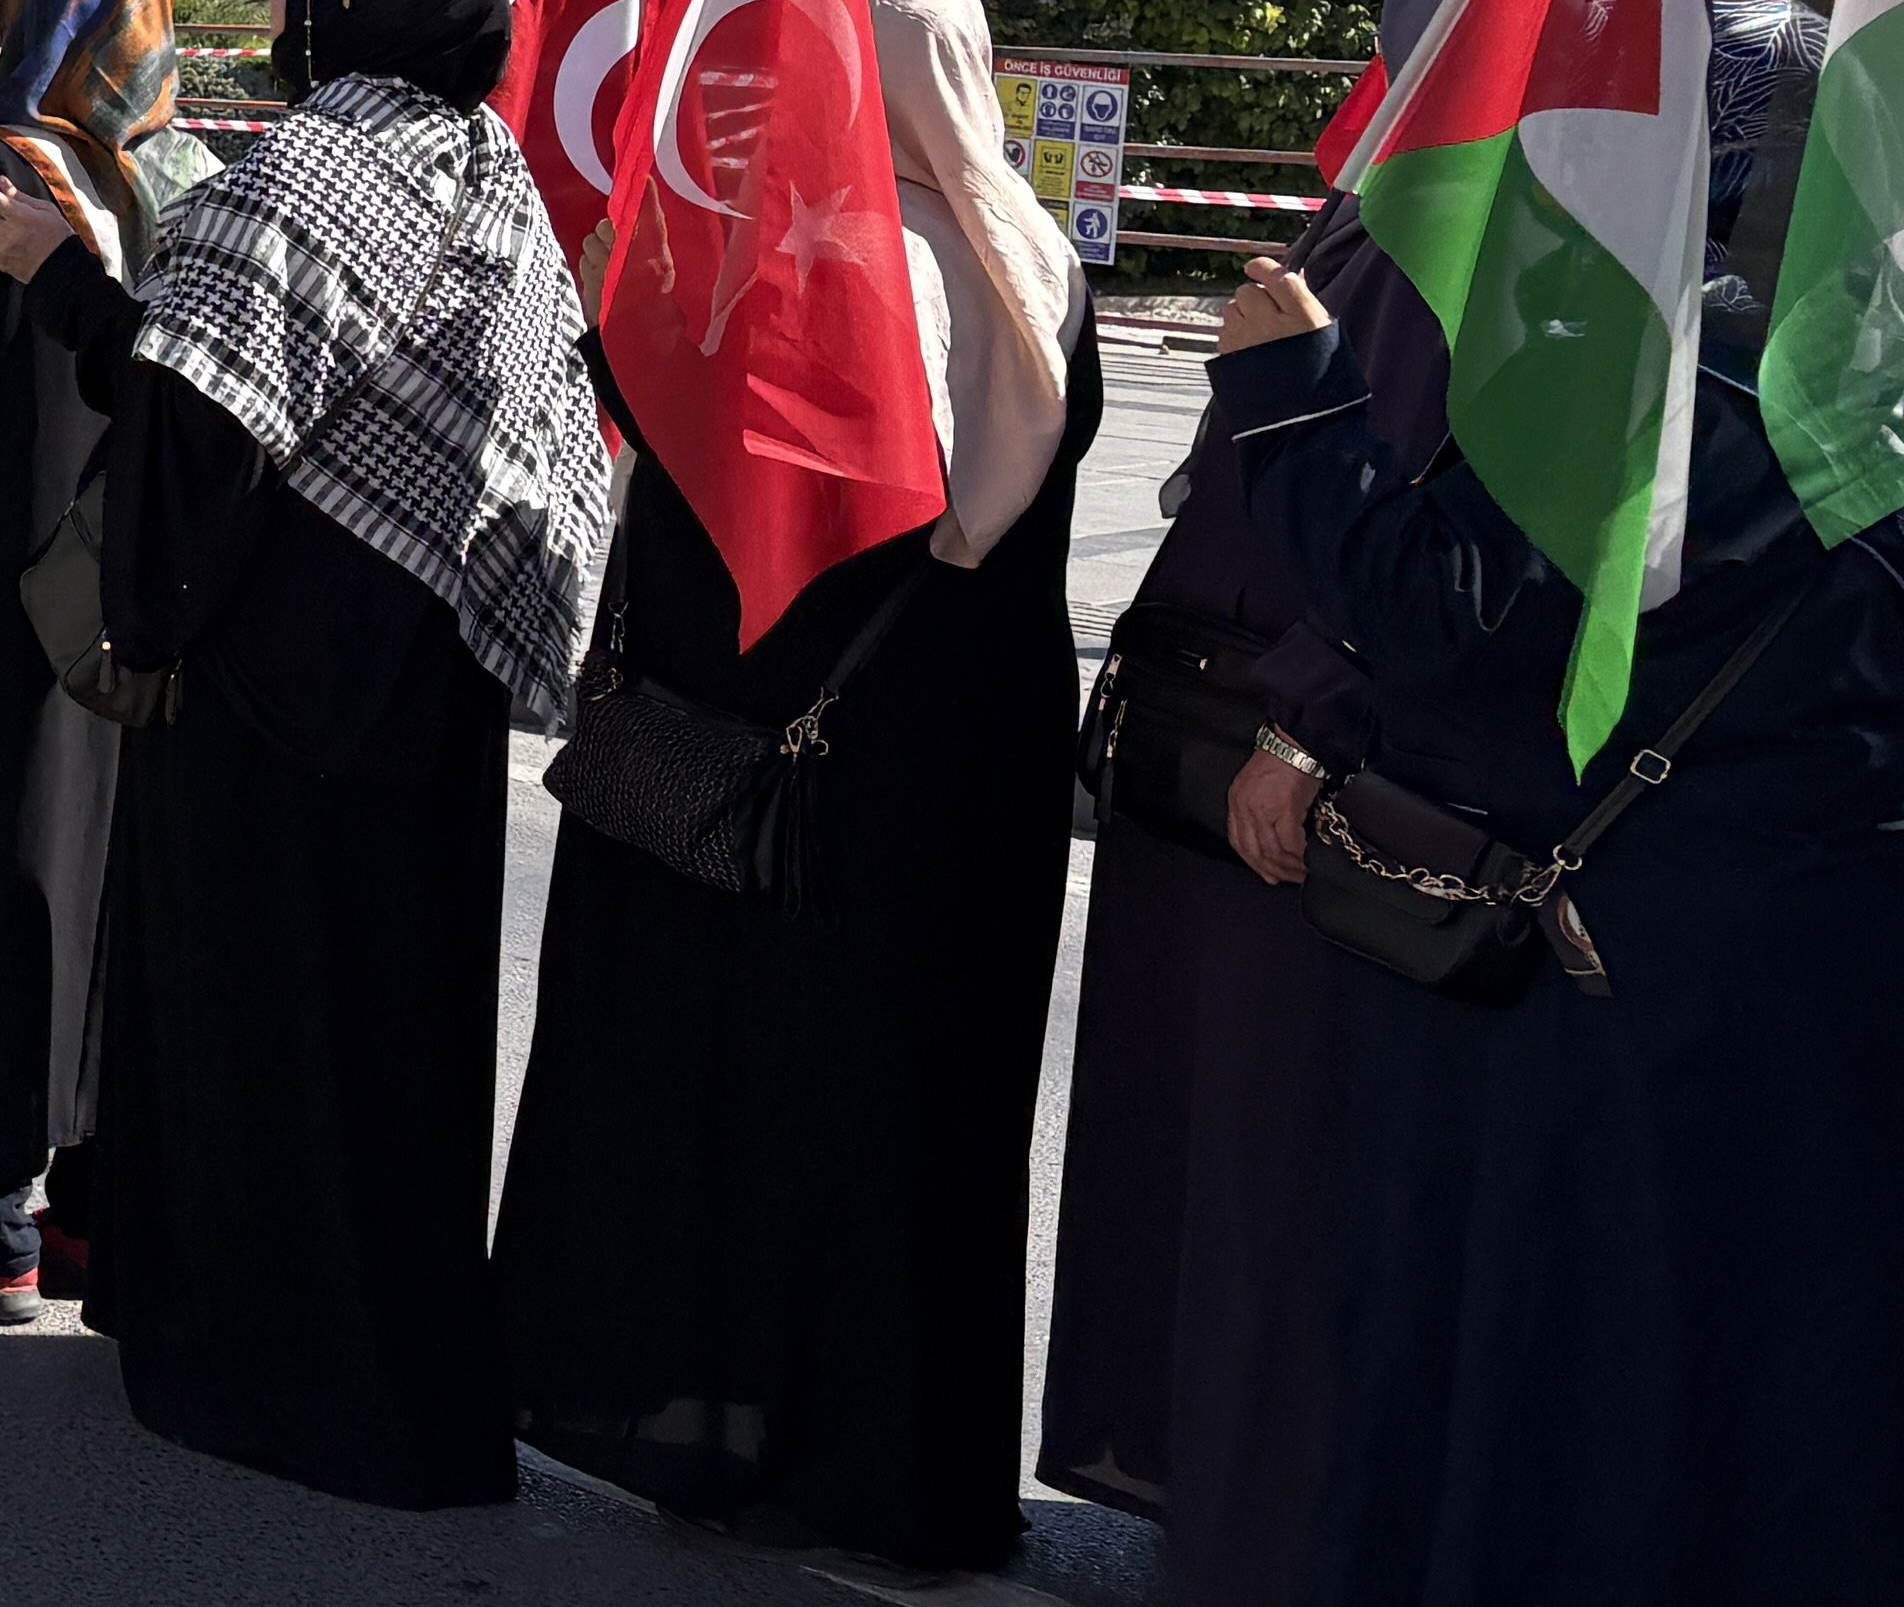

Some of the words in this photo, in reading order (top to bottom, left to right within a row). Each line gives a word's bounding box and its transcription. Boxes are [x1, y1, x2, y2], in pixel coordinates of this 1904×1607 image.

[1003, 58, 1038, 74] ÖNCE
[1039, 61, 1052, 77] İŞ
[1054, 62, 1122, 83] GÜVENLİĞİ
